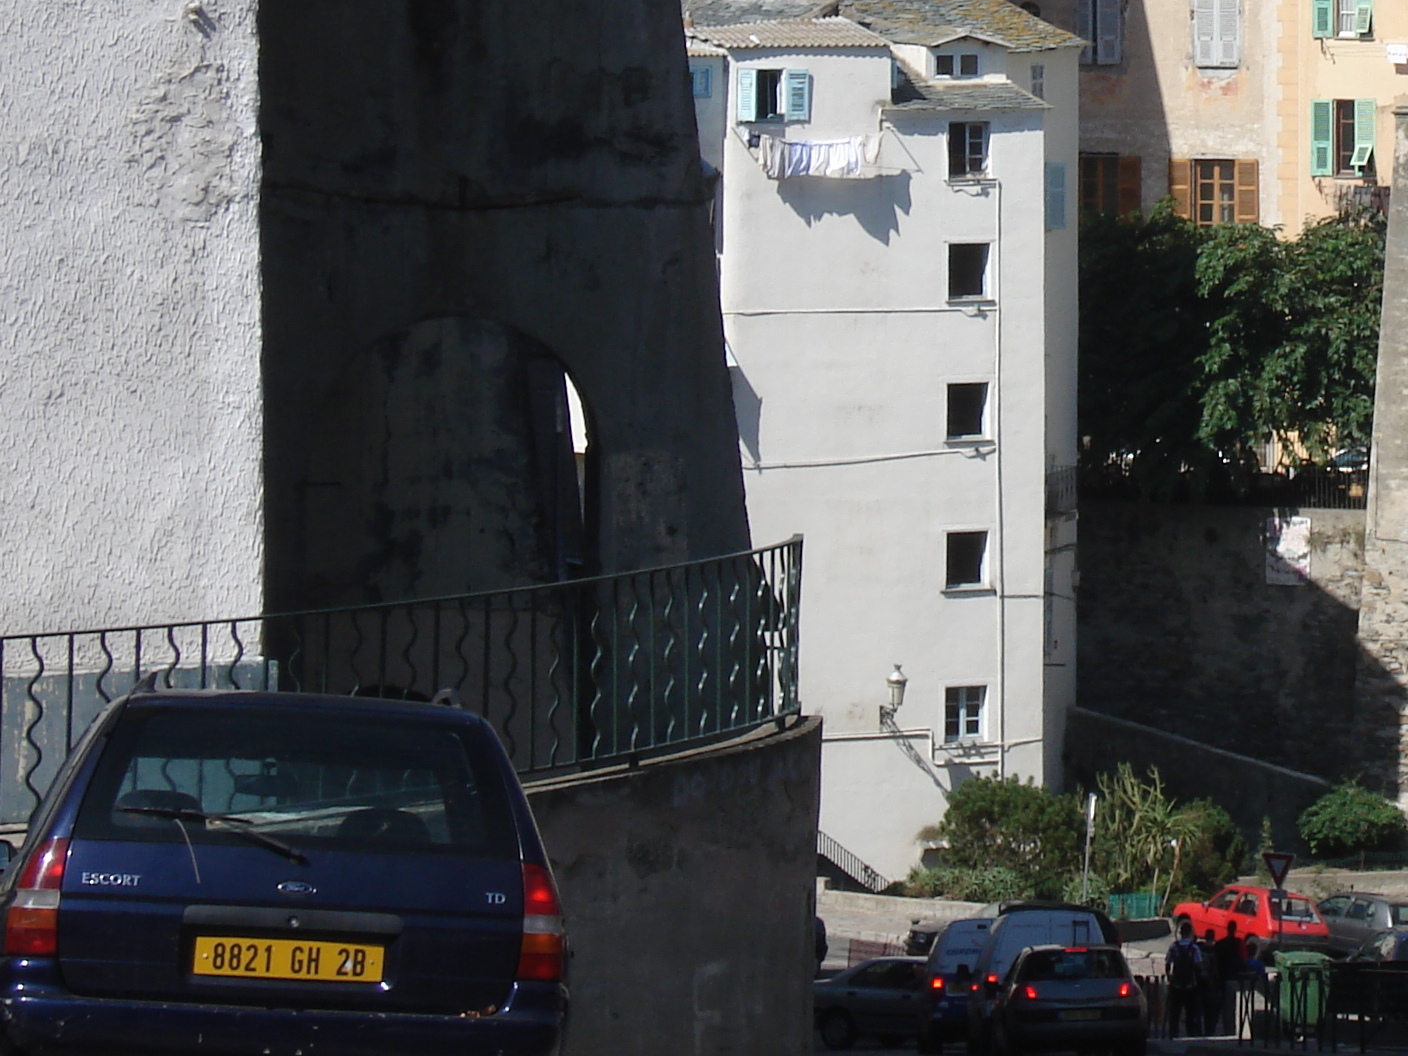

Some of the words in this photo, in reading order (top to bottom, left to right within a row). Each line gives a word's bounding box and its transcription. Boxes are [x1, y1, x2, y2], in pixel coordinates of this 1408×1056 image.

[81, 872, 141, 886] ESCORT
[485, 892, 506, 904] TD
[212, 942, 273, 973] 8821
[290, 946, 321, 975] GH
[336, 948, 367, 977] 2B
